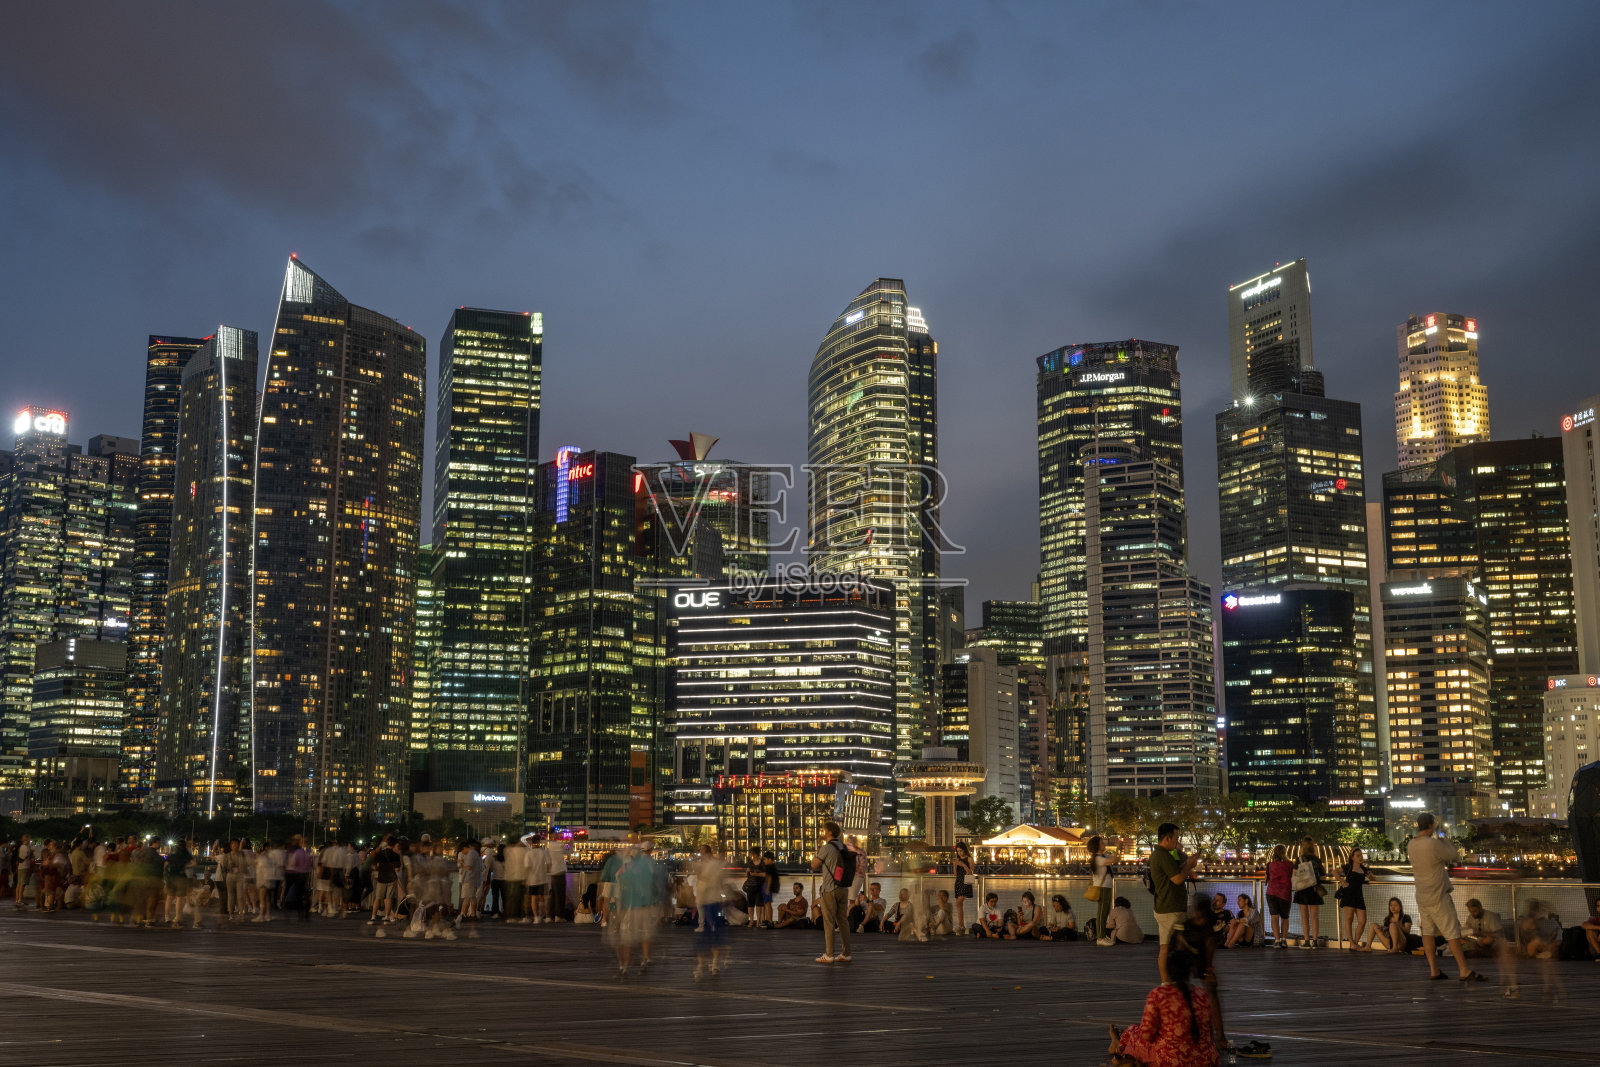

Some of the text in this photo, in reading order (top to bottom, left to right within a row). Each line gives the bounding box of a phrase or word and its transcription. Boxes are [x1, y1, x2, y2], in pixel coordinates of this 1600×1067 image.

[1080, 372, 1125, 382] J.P.Morgan
[568, 464, 593, 480] ntuc
[674, 591, 720, 608] OUE
